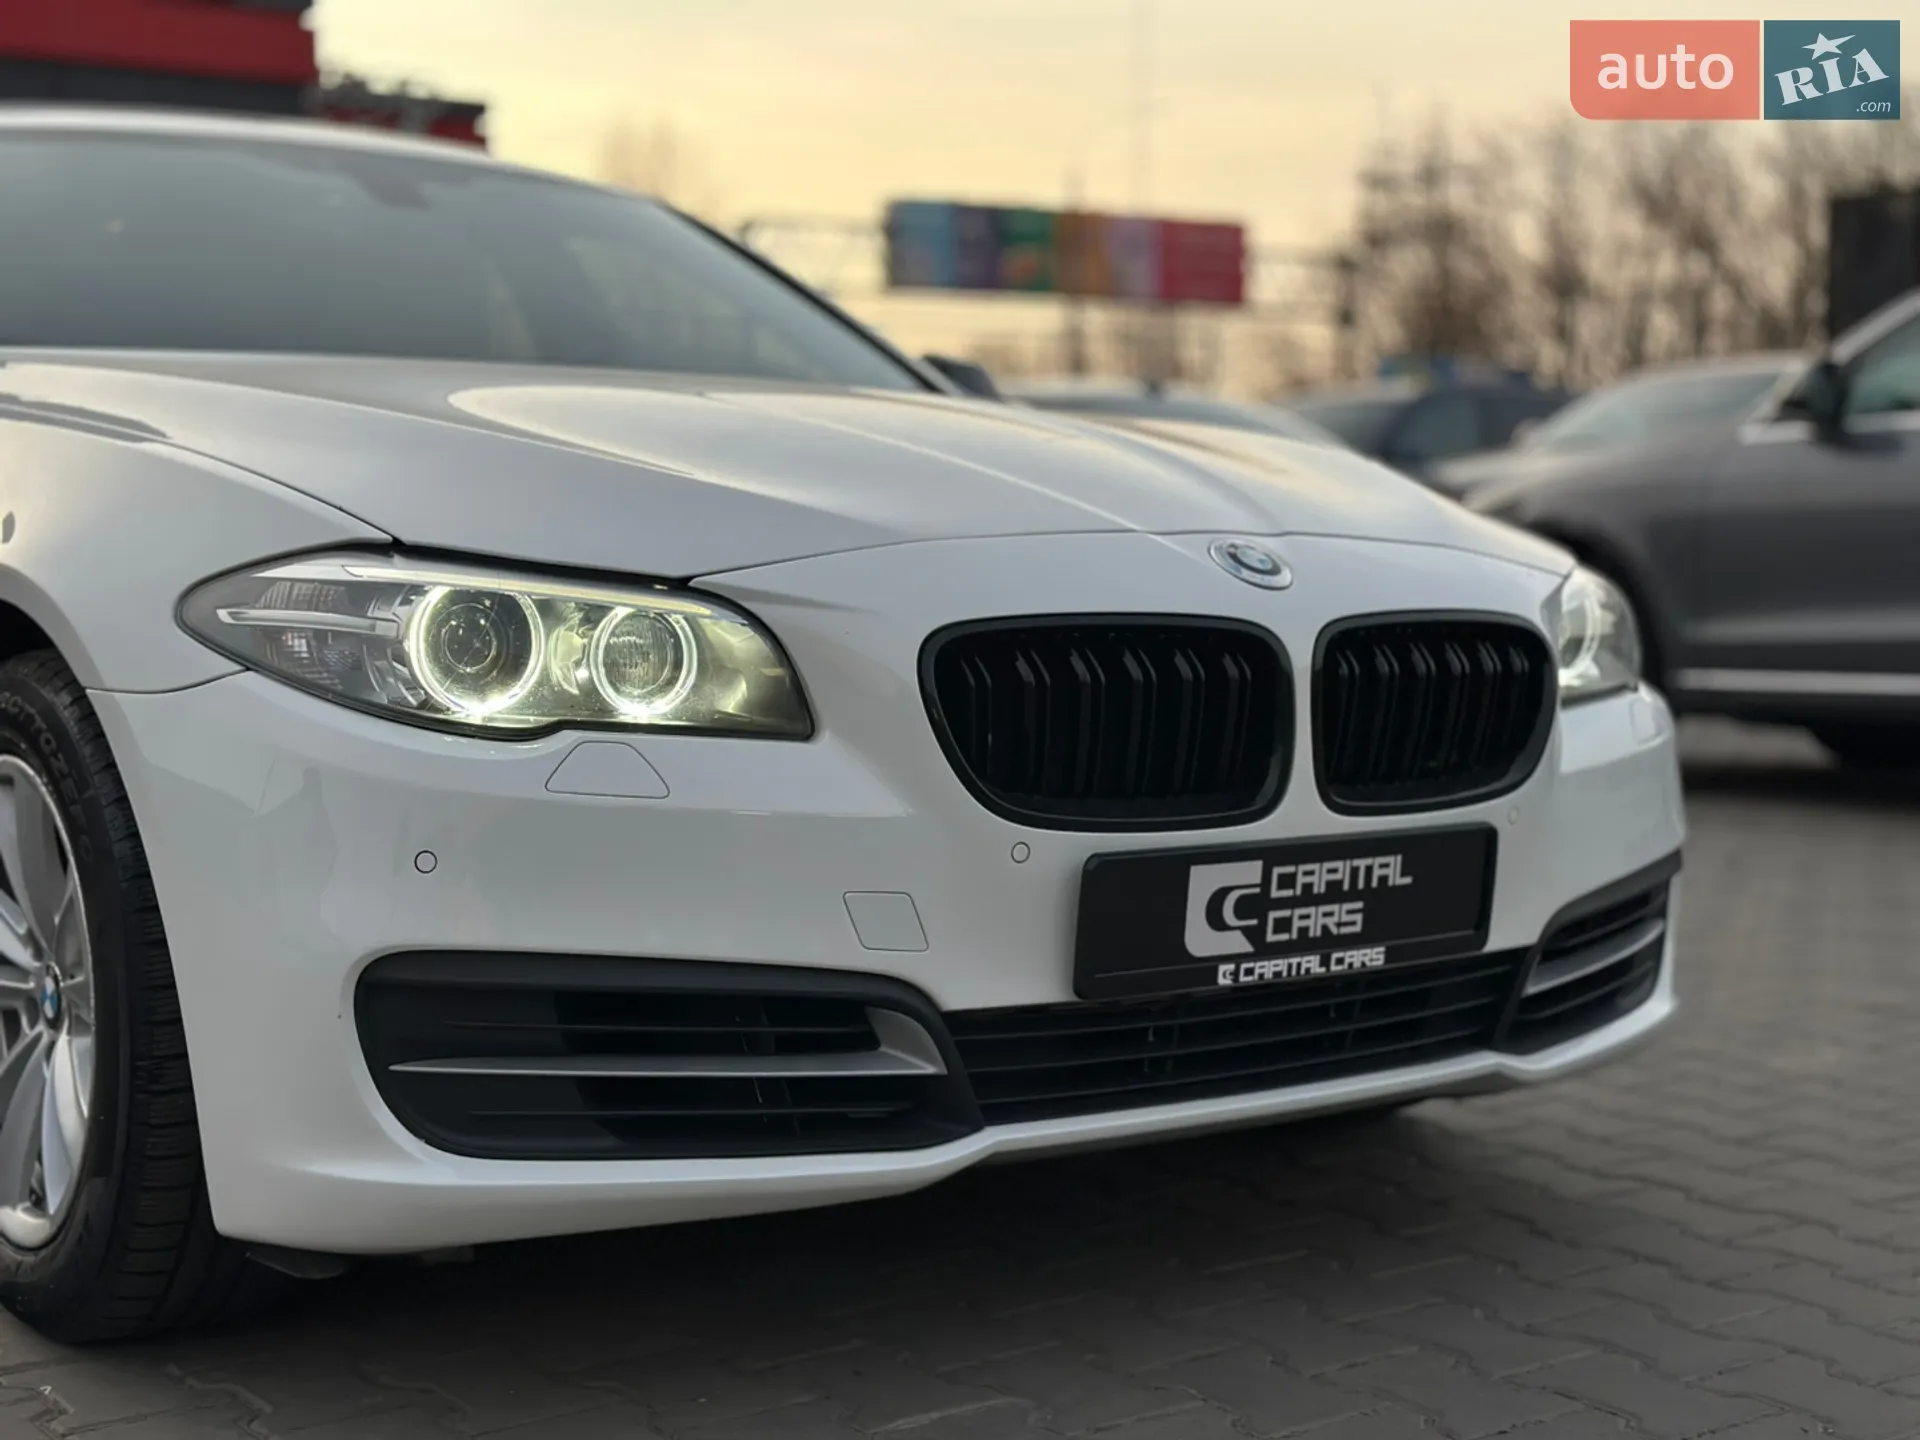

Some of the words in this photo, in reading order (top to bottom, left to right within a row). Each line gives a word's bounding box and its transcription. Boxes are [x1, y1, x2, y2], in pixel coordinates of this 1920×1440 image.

[1269, 854, 1413, 899] CAPITAL
[1265, 901, 1365, 943] CARS
[1238, 954, 1327, 983] CAPITAL
[1330, 946, 1386, 972] CARS
